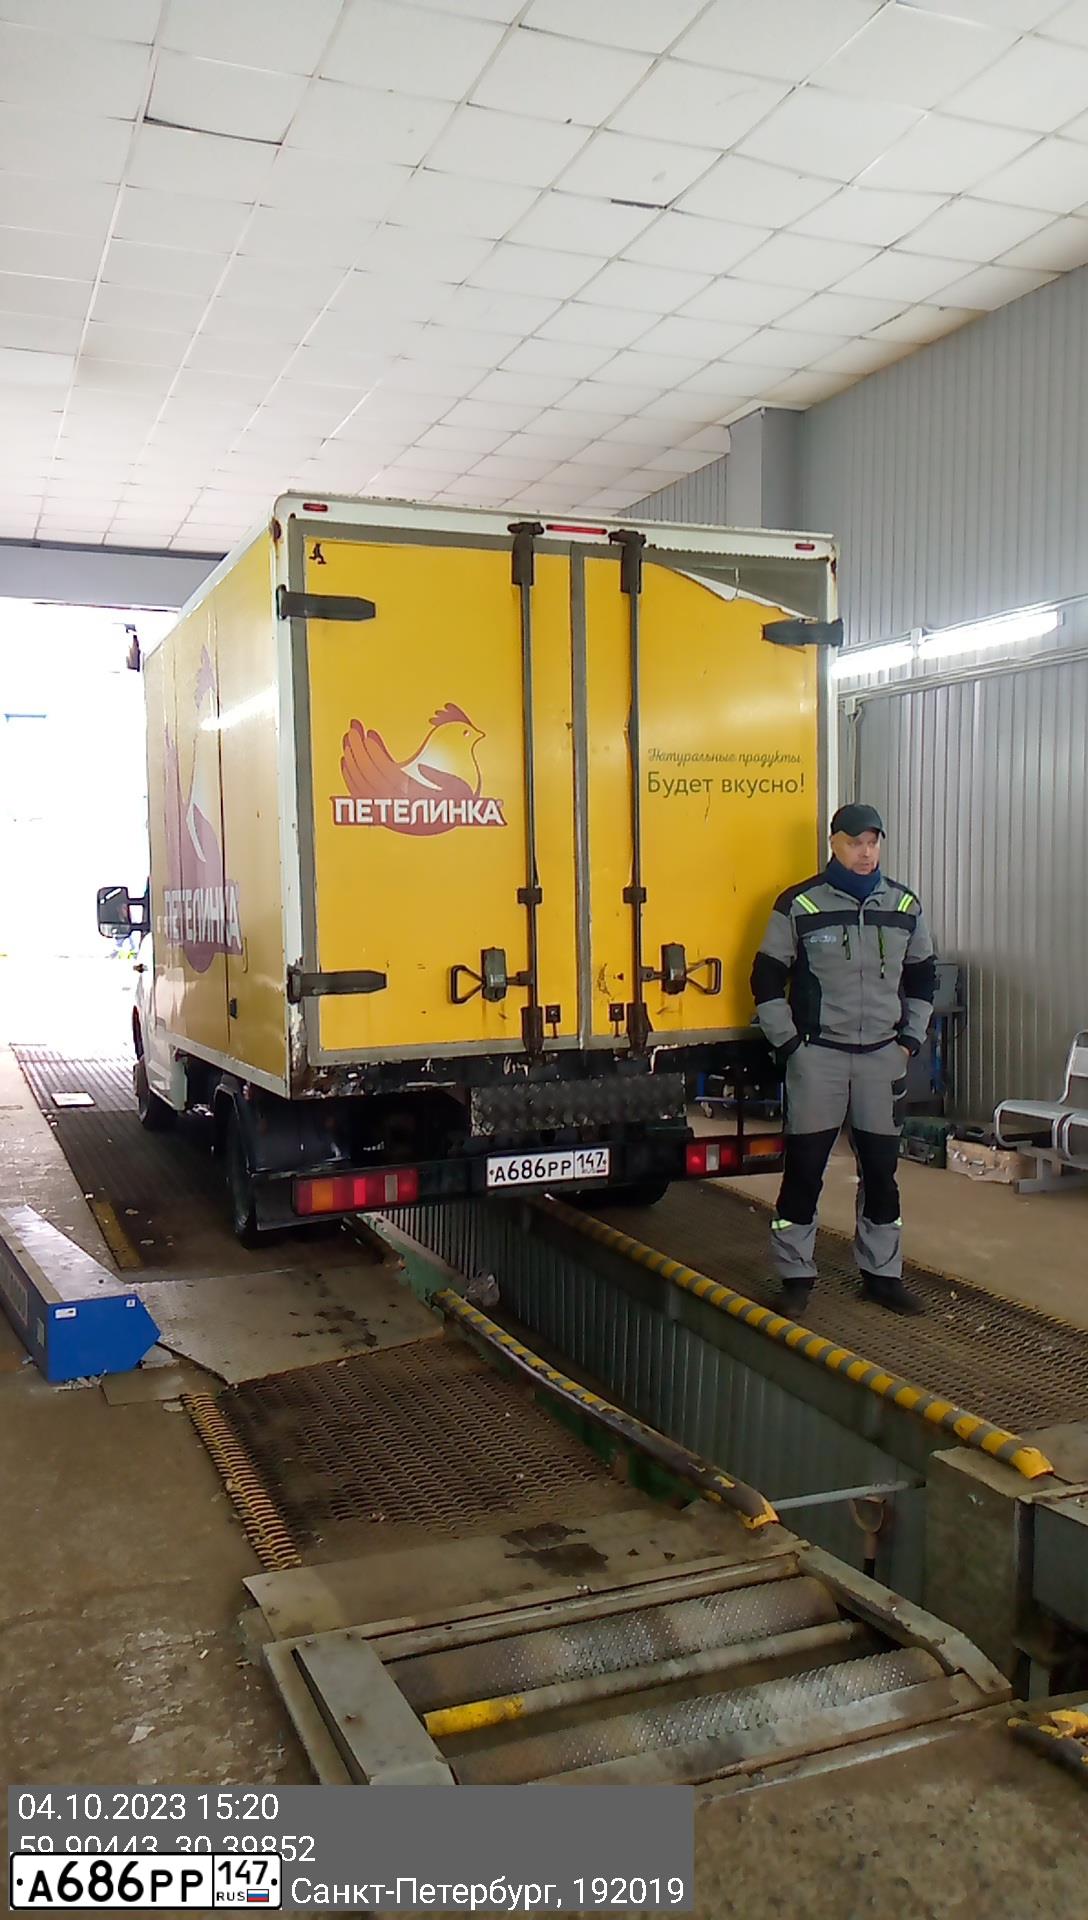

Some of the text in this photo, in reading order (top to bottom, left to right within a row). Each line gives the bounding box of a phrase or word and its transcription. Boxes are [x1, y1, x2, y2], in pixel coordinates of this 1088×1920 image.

[648, 748, 801, 767] Натуральные продукты
[648, 771, 805, 798] Будет вкусно!
[334, 798, 505, 825] ПЕТЕЛИНКА
[577, 1152, 604, 1168] 147
